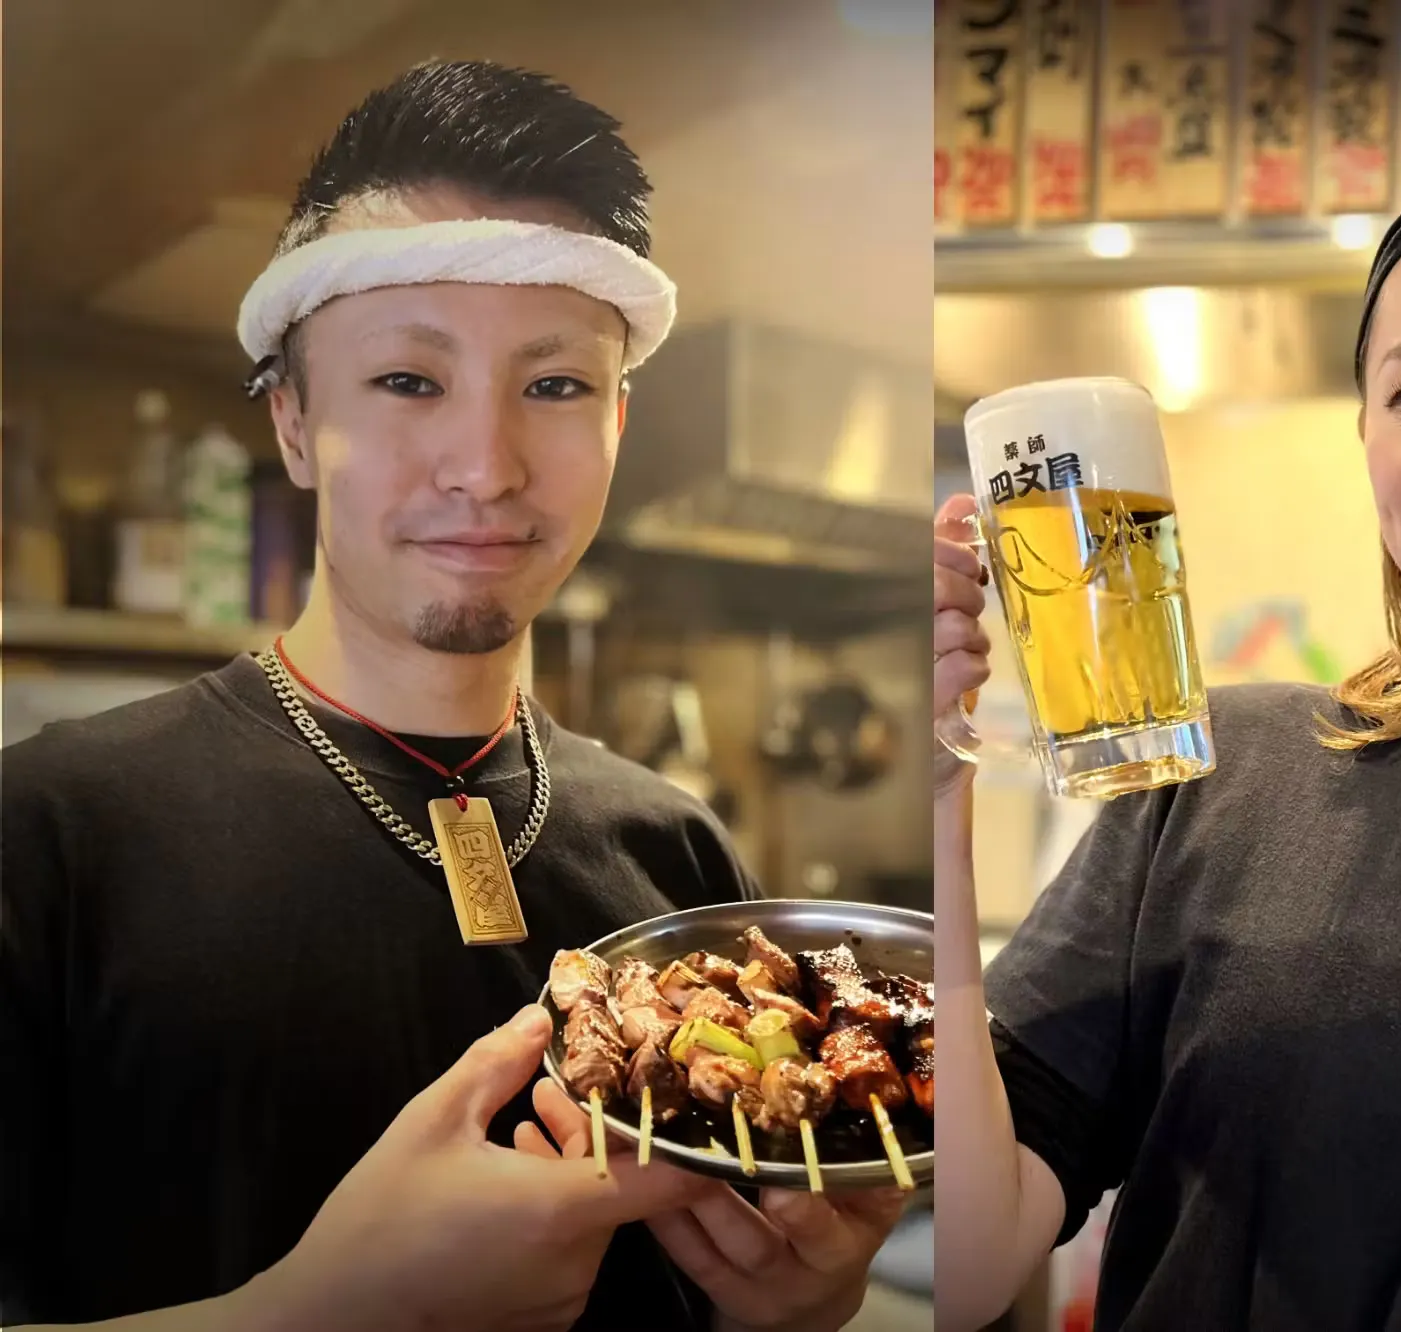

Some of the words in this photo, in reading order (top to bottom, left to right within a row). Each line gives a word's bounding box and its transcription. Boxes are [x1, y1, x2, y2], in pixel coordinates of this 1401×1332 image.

[1003, 434, 1046, 461] 薬師
[988, 452, 1084, 505] 四文屋
